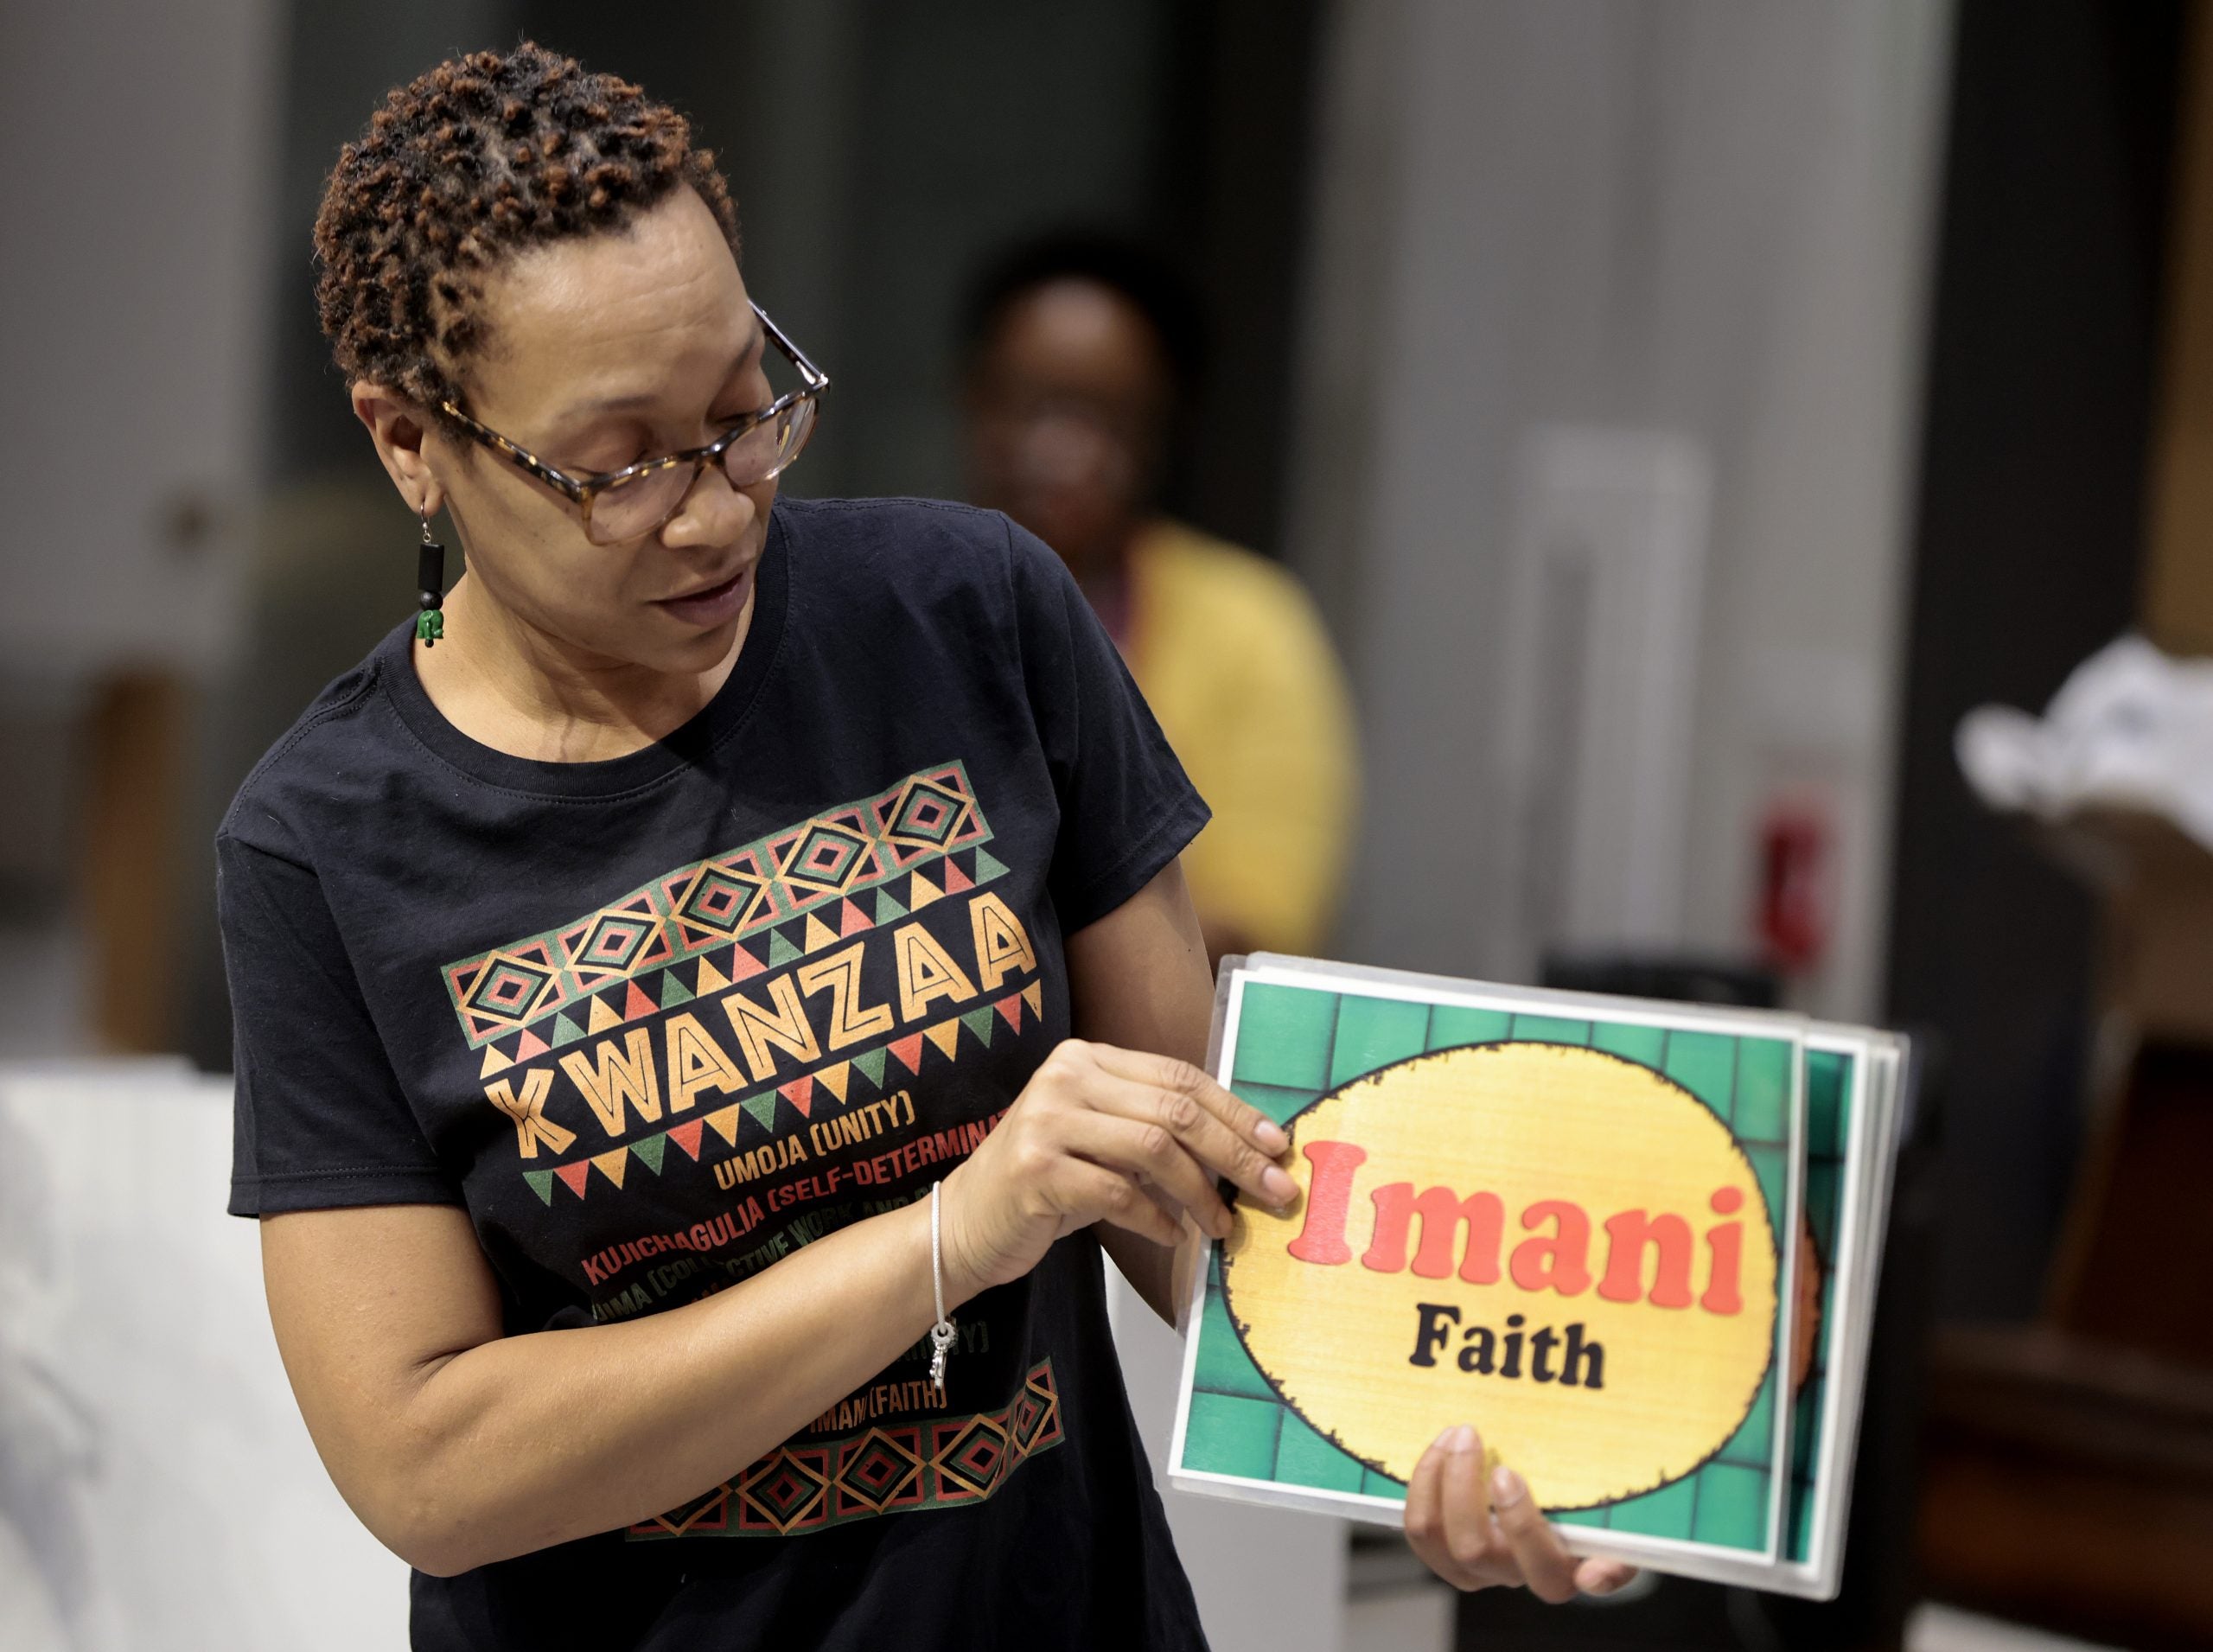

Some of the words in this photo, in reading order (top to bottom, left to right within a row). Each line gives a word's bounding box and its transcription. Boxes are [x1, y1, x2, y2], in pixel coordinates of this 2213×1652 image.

[484, 891, 1037, 1159] KWANZAA
[713, 1133, 808, 1190] UMOJA
[809, 1088, 916, 1157] (UNITY)
[580, 1195, 766, 1287] KUJICHAGULIA
[1286, 1139, 1746, 1317] Imani
[1408, 1302, 1607, 1390] Faith
